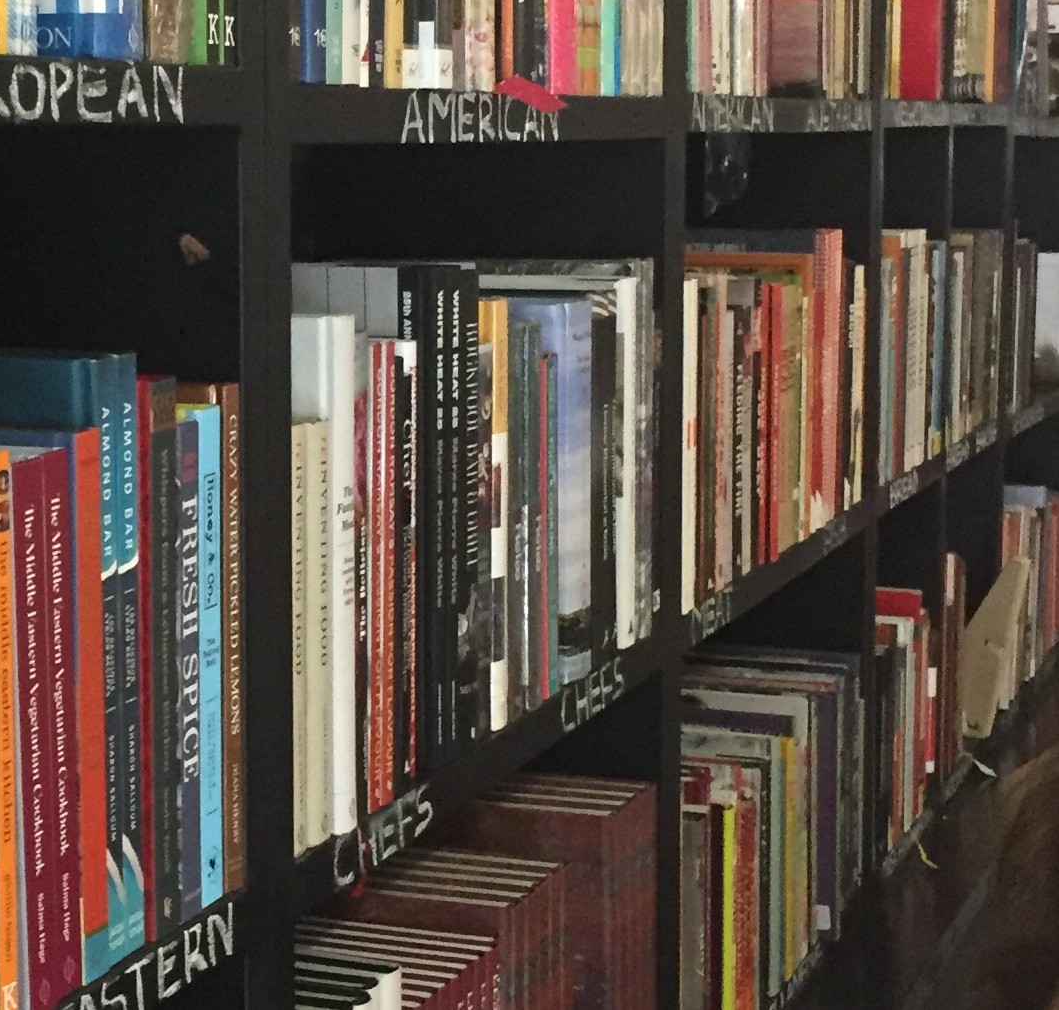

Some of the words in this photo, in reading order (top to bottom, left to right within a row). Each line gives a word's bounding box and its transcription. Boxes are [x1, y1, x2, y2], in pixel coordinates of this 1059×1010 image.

[207, 13, 220, 45] K
[223, 15, 236, 47] K
[400, 91, 561, 144] AMERICAN
[436, 289, 445, 350] WHITE
[451, 289, 460, 350] WHITE
[436, 353, 445, 402] HEAT
[451, 353, 460, 401] HEAT
[121, 401, 134, 496] ALMOND
[229, 413, 239, 480] CRAZY
[436, 407, 445, 431] 25
[451, 407, 459, 430] 25
[100, 406, 112, 502] ALMOND
[24, 503, 35, 539] The
[49, 492, 62, 535] The
[103, 513, 113, 558] BAR
[123, 507, 134, 550] BAR
[229, 487, 239, 551] WATER
[0, 540, 9, 578] the
[25, 543, 37, 608] Middle
[51, 532, 63, 595] Middle
[181, 493, 199, 640] FRESH
[0, 585, 10, 661] middle
[52, 596, 63, 666] Eastern
[229, 557, 239, 649] PICKLED
[26, 611, 39, 681] Eastern
[1, 667, 12, 753] eastern
[54, 667, 68, 763] Vegetarian
[181, 651, 201, 785] SPICE
[230, 654, 240, 736] LEMONS
[560, 656, 626, 734] CHEFS
[28, 682, 42, 782] Vegetarian
[108, 734, 116, 783] SHARON
[128, 724, 137, 773] SHARON
[2, 758, 13, 844] kitchen
[32, 783, 46, 877] Cookbook
[57, 765, 71, 857] Cookbook
[109, 786, 118, 843] SALLOUM
[129, 776, 138, 832] SALLOUM
[231, 799, 240, 844] HENRY
[333, 783, 434, 887] CHEFS
[0, 980, 19, 1010] K
